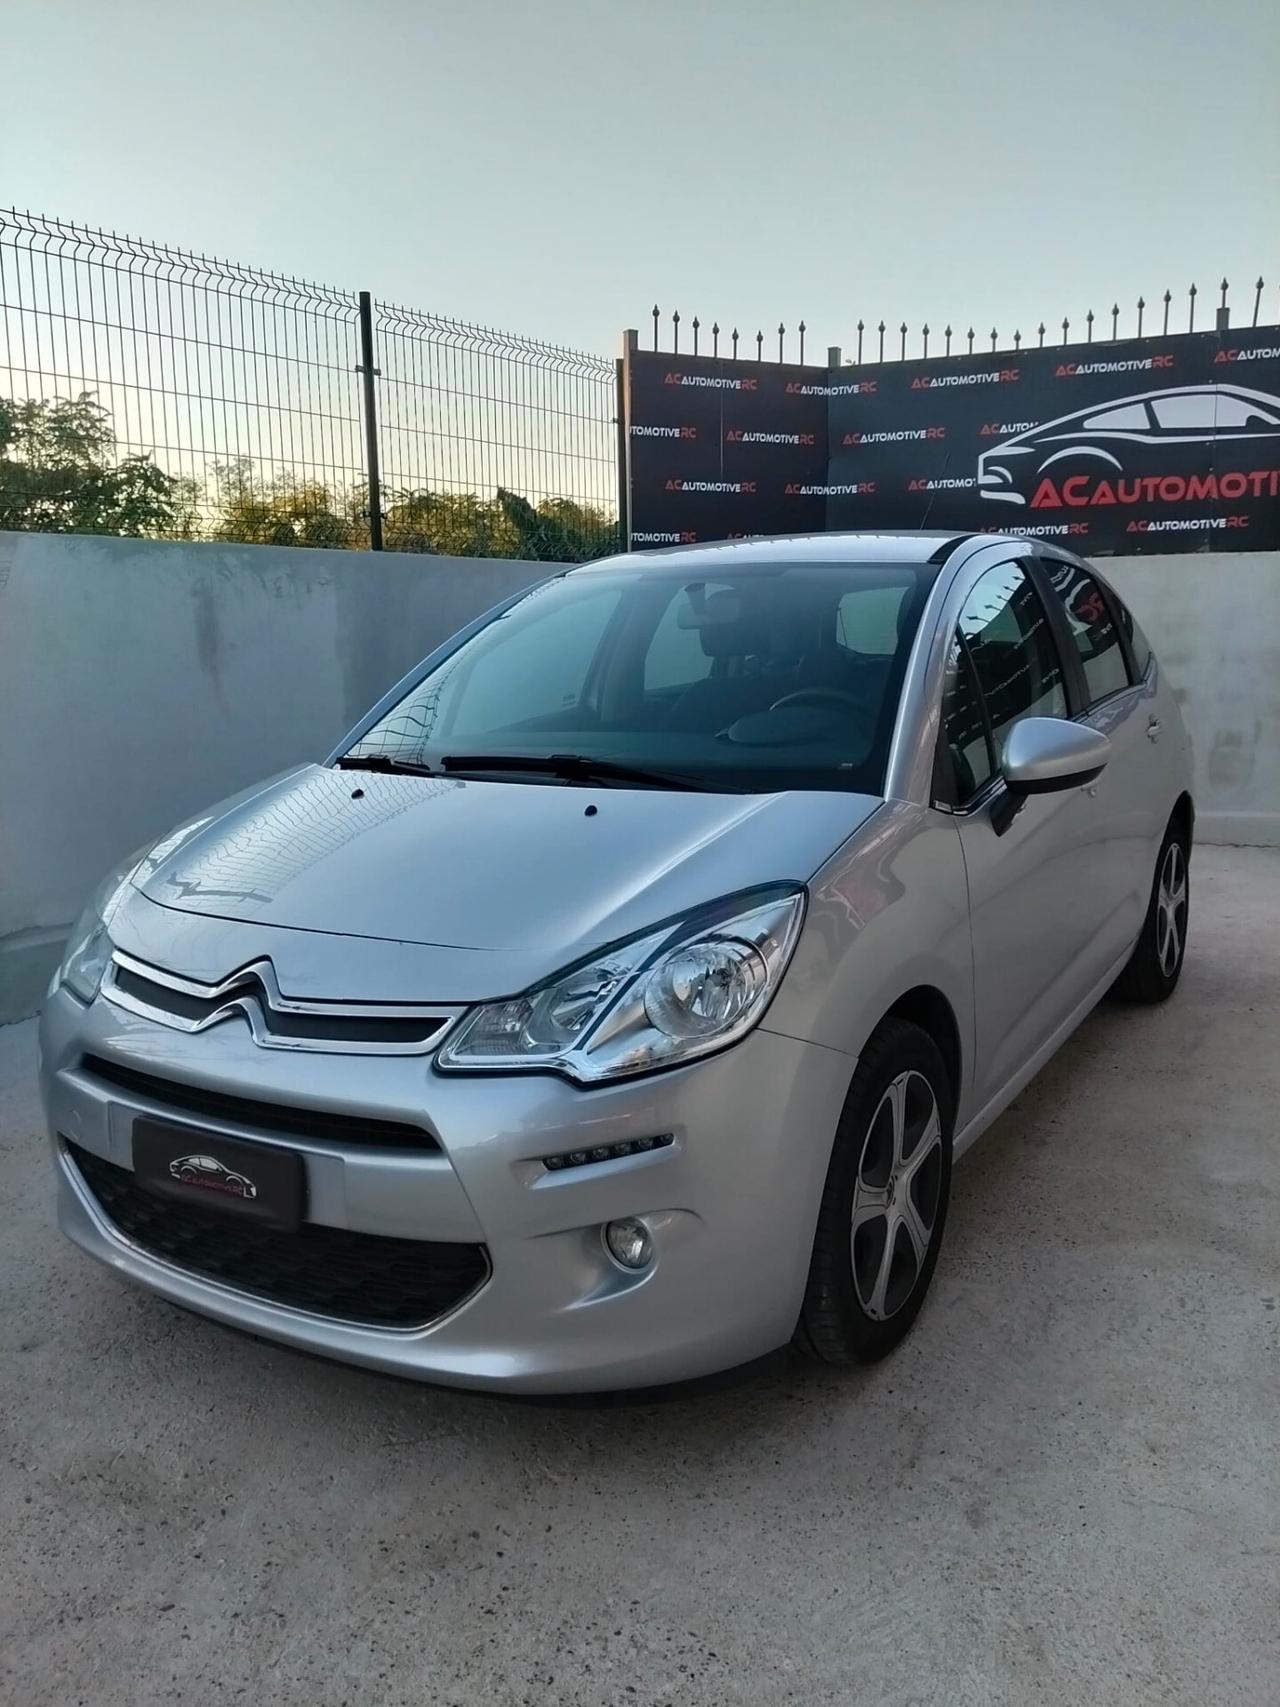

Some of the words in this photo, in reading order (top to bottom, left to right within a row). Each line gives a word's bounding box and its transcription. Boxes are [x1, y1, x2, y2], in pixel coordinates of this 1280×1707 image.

[1055, 355, 1174, 377] ACAUTOMOTIVERC
[664, 372, 758, 390] ACAUTOMOTIVERC
[911, 369, 1020, 389] ACAUTOMOTIVERC
[785, 380, 878, 396] ACAUTOMOTIVERC
[726, 430, 815, 445] ACAUTOMOTIVERC
[842, 427, 946, 445] ACAUTOMOTIVERC
[665, 479, 757, 494] ACAUTOMOTIVERC
[785, 482, 876, 495] ACAUTOMOTIVERC
[1030, 471, 1280, 508] ACAUTOMOTI
[1127, 516, 1249, 533] ACAUTOMOTIVERC
